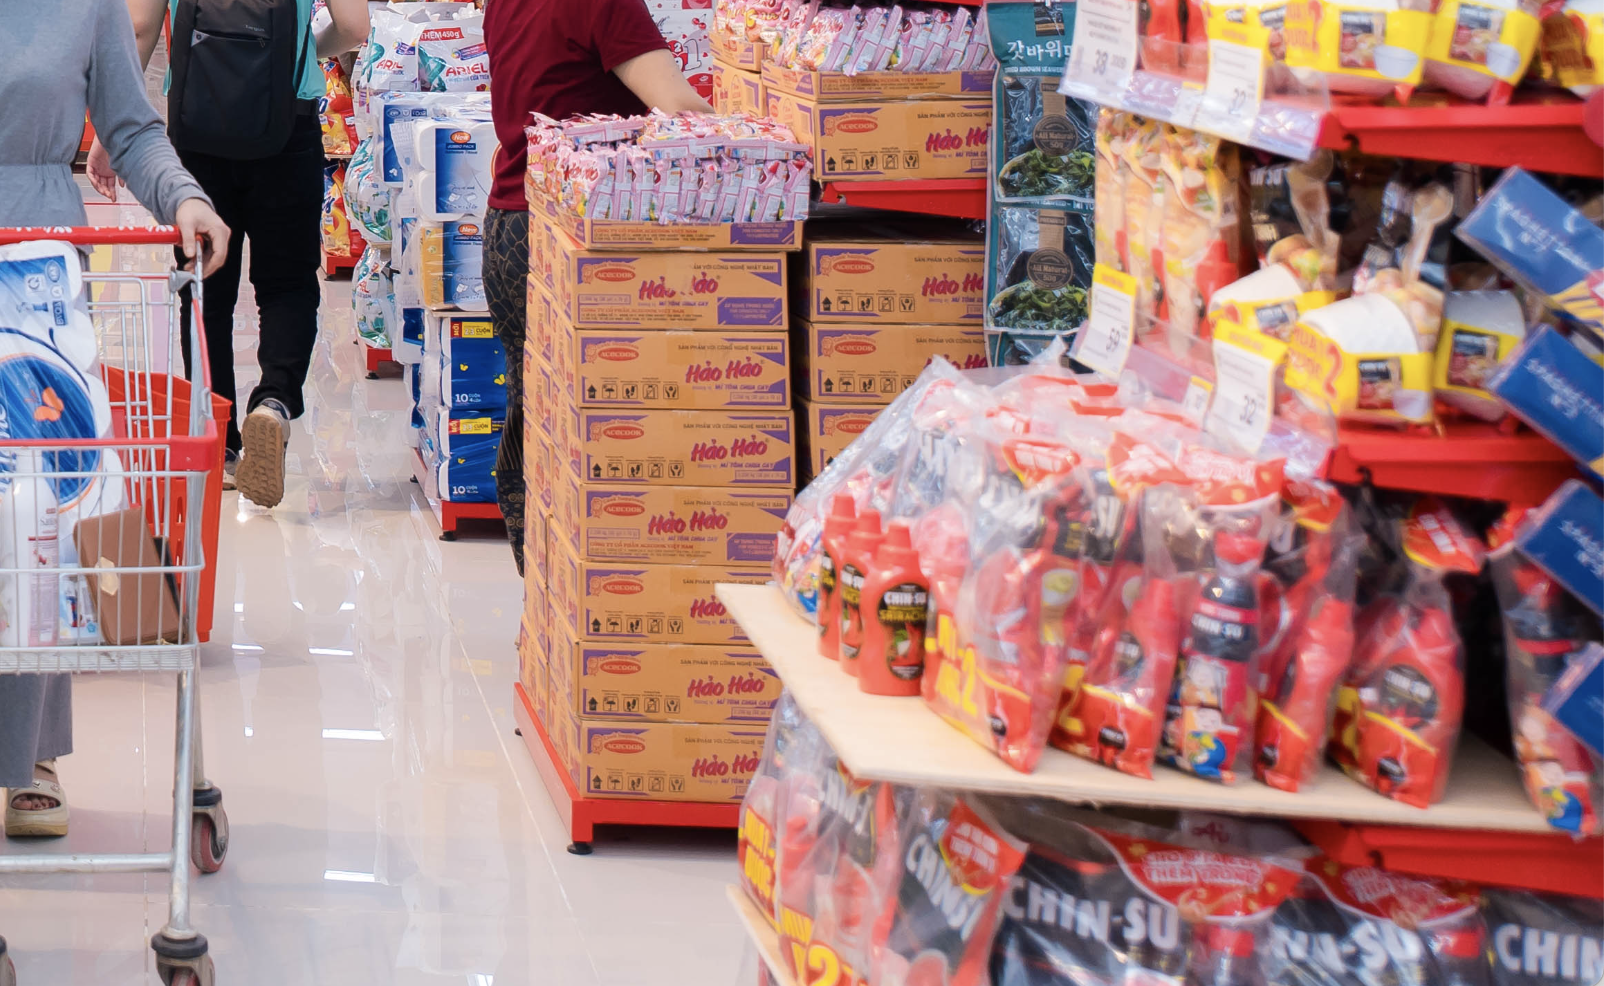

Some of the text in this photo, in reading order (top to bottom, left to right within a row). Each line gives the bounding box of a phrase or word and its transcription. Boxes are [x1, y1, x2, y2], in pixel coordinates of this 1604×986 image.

[446, 63, 488, 76] ARIEL
[596, 271, 633, 279] ACECOOK
[922, 273, 959, 297] Hảo
[600, 350, 636, 358] ACECOOK
[686, 356, 763, 383] Hảo Hảo
[455, 393, 468, 403] 10
[605, 428, 642, 436] ACECOOK
[691, 435, 768, 461] Hảo Hảo
[452, 486, 466, 494] 10
[648, 507, 728, 536] Hảo Hảo
[688, 672, 765, 698] Hảo Hảo
[1004, 875, 1180, 952] CHIN-SU
